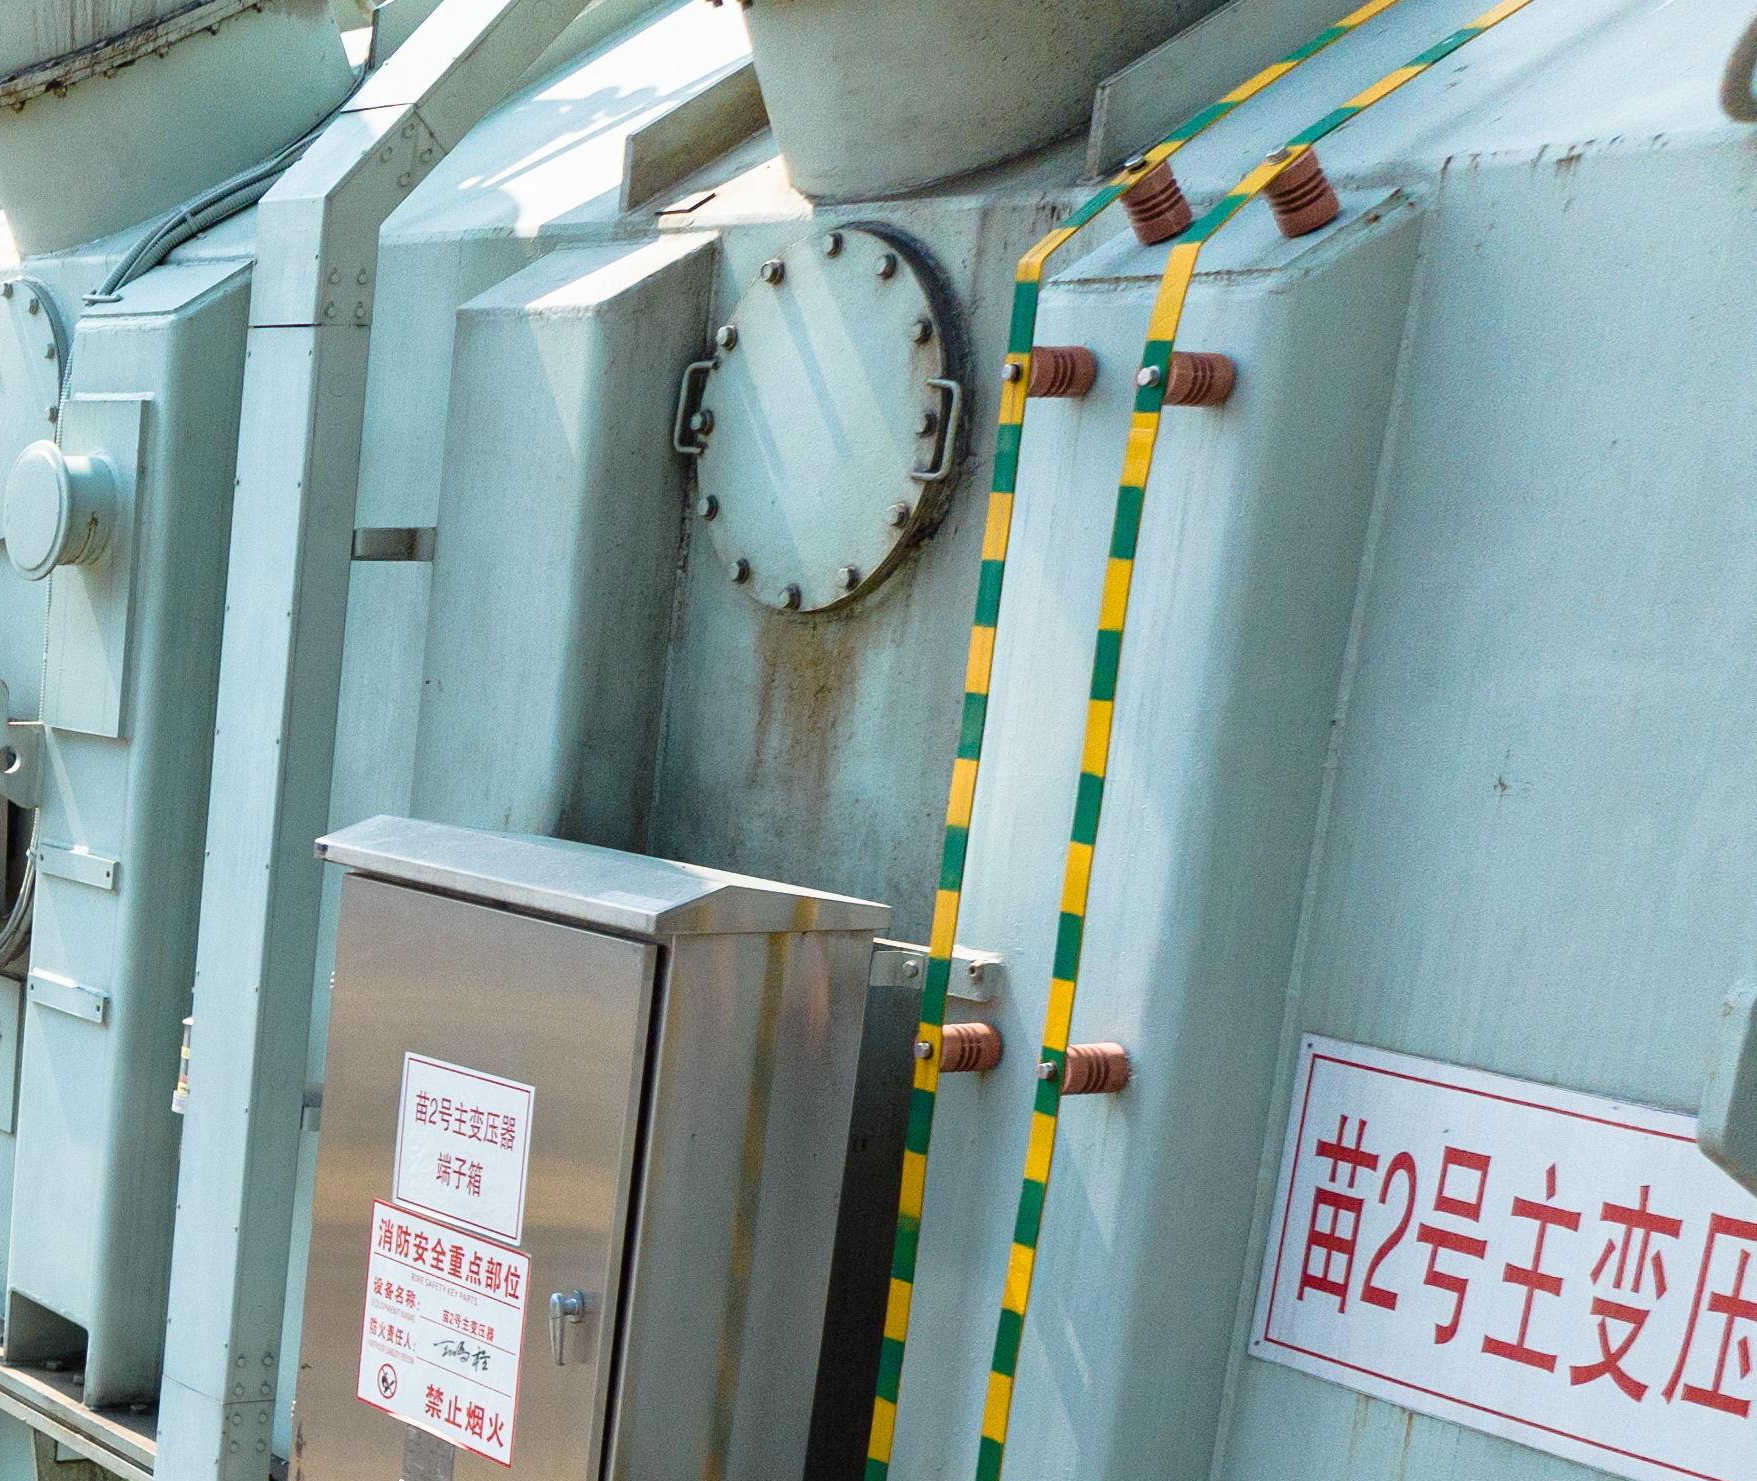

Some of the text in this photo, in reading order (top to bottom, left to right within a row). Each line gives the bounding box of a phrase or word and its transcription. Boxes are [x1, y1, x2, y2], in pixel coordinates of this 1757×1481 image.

[415, 1090, 516, 1152] 苗2号主变压器
[435, 1152, 483, 1197] 端子箱
[378, 1217, 520, 1300] 消防安全重点部位
[1296, 1113, 1757, 1419] 苗2号主变压
[425, 1278, 445, 1293] SAFETY
[447, 1286, 458, 1299] KEY
[458, 1290, 478, 1306] PARTS
[442, 1309, 494, 1341] 苗2号主变压器
[425, 1383, 505, 1449] 禁止烟火
